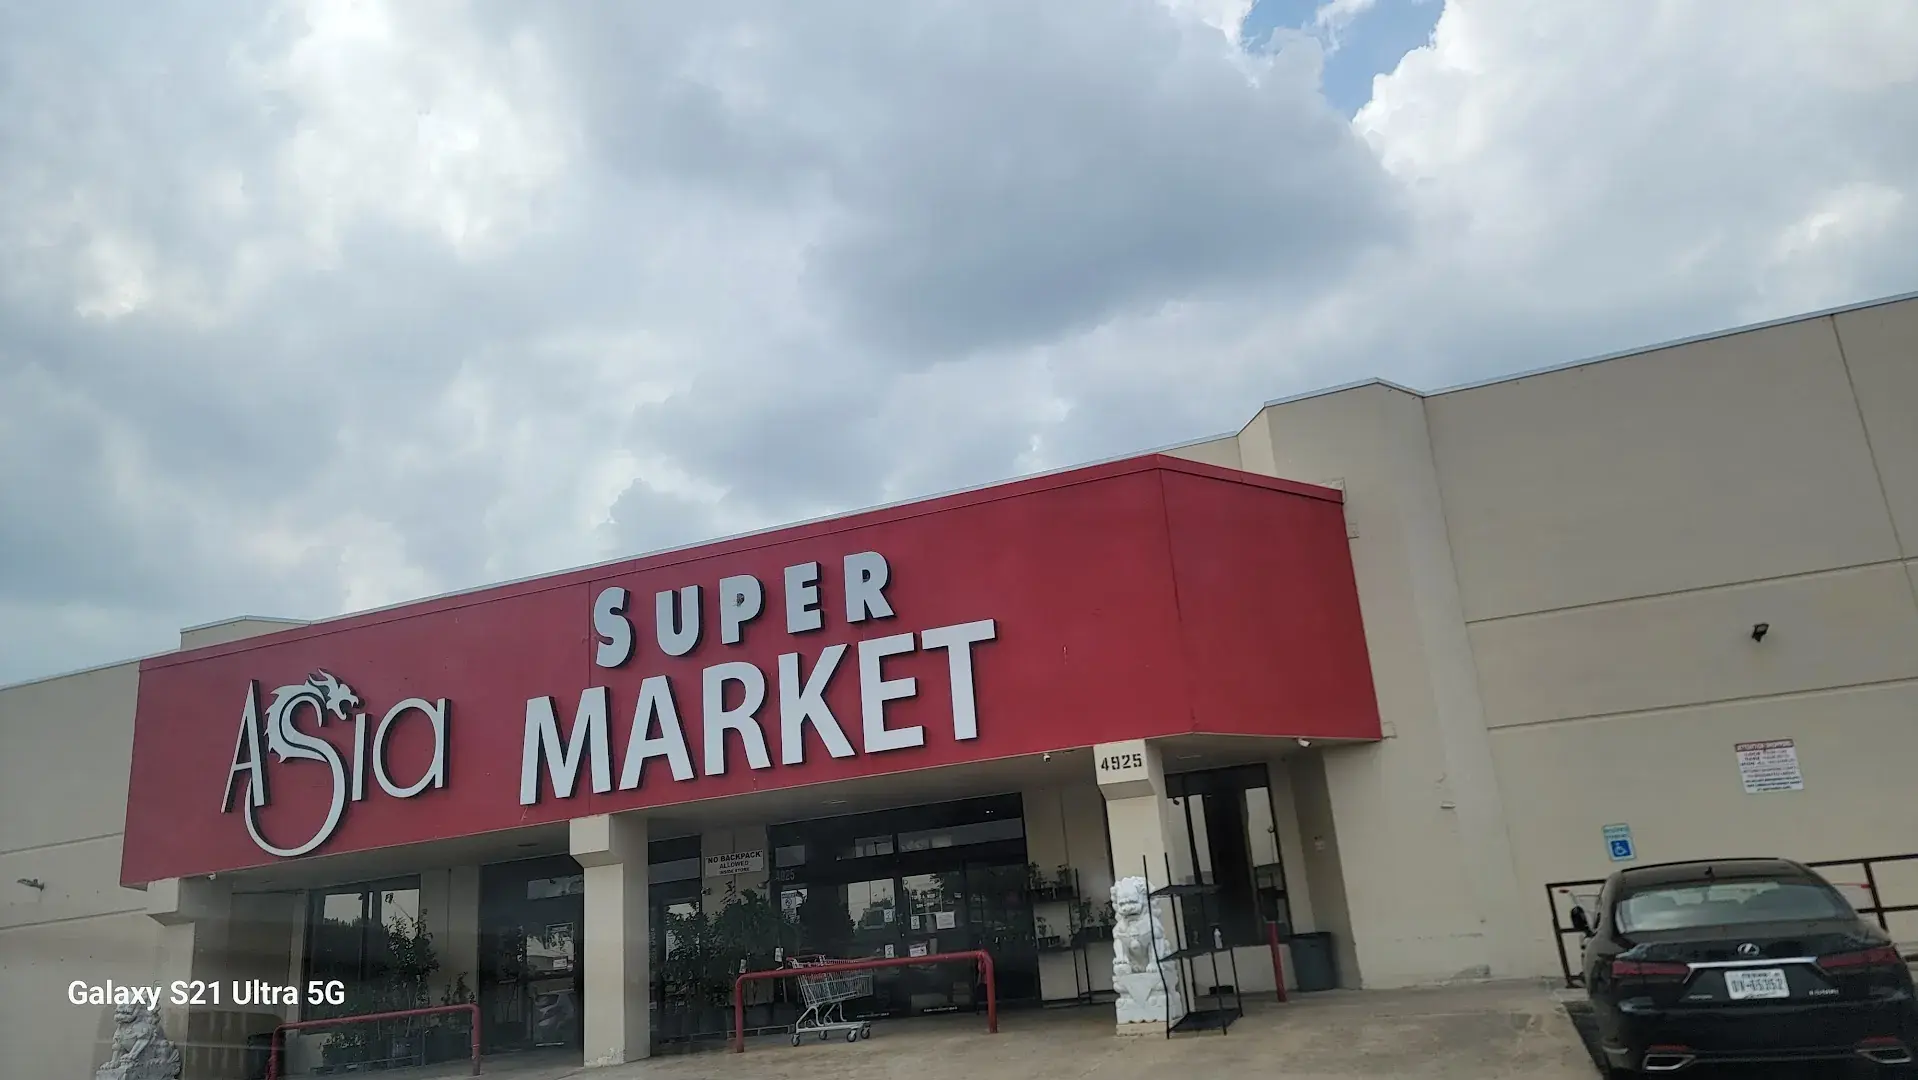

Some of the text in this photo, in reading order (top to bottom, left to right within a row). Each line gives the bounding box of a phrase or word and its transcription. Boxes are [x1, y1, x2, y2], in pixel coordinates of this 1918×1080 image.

[593, 551, 896, 669] SUPER
[520, 618, 997, 806] MARKET
[1101, 753, 1142, 771] 4925
[707, 851, 761, 864] NO BACKPACK
[719, 860, 749, 869] ALLOWED
